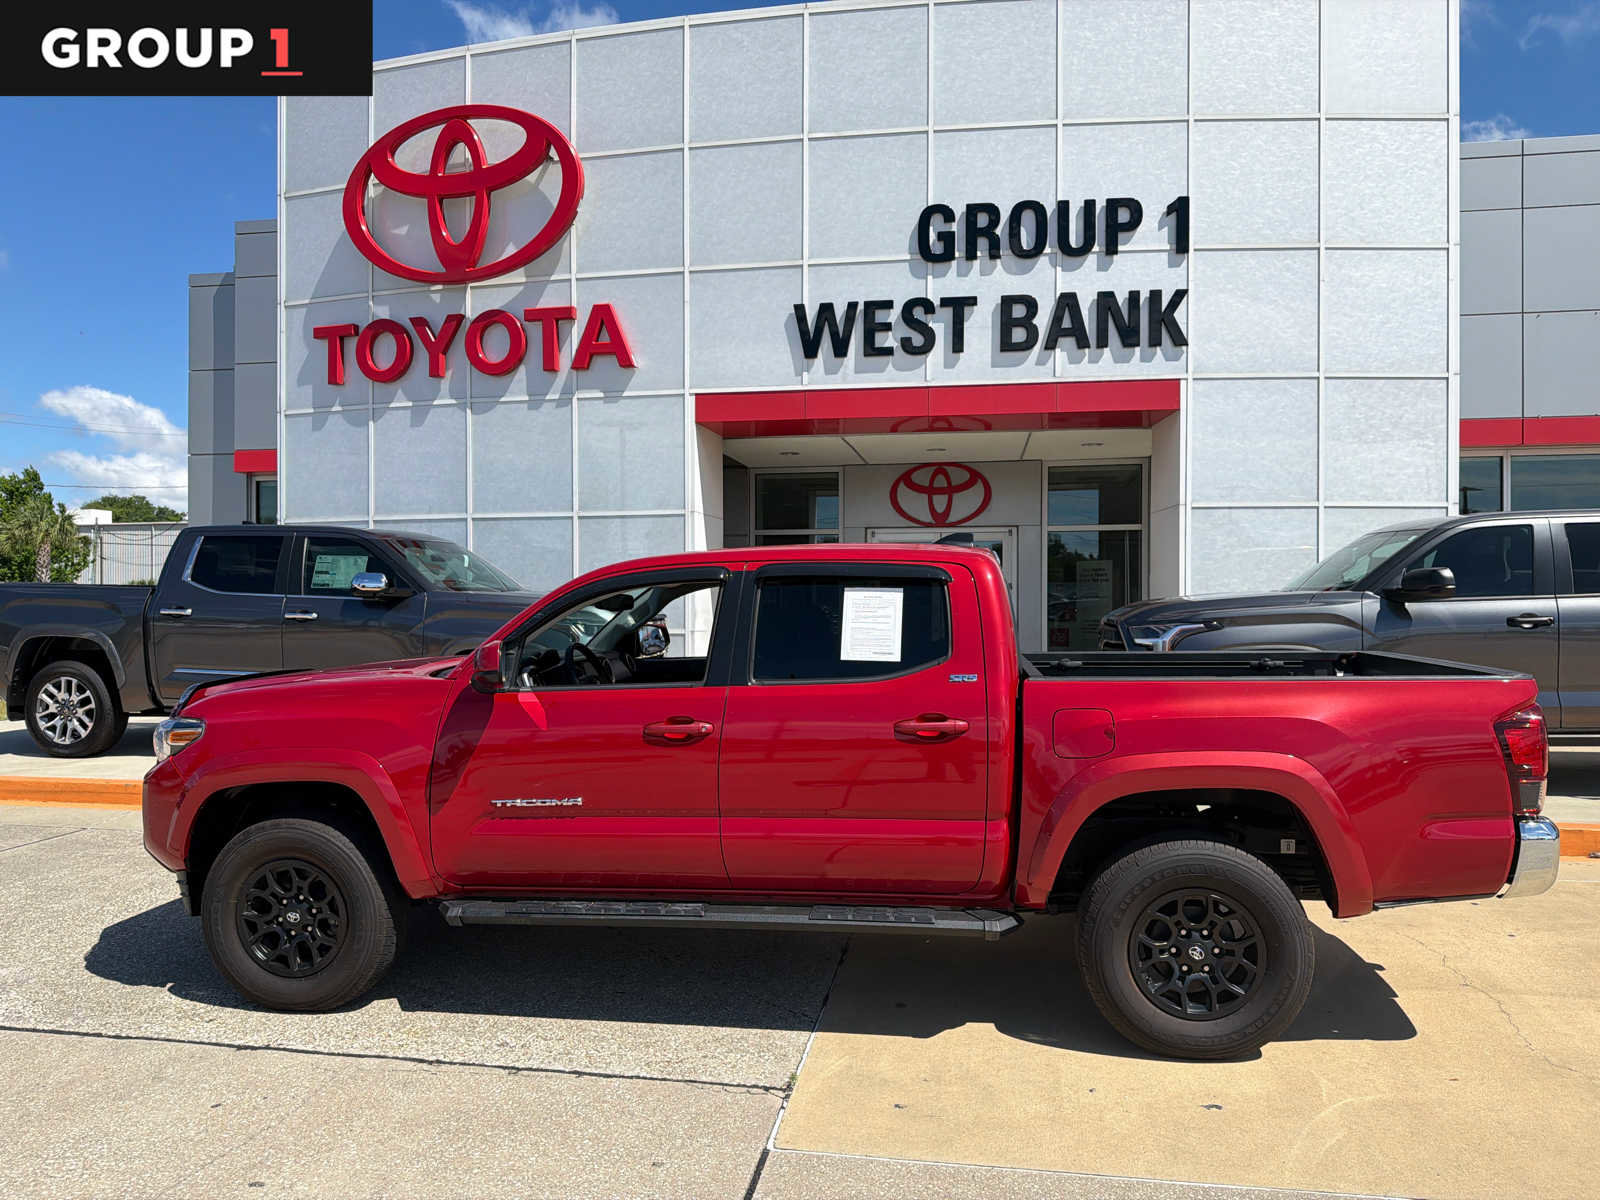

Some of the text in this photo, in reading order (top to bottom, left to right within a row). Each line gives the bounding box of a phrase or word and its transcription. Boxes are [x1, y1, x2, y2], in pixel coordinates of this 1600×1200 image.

[917, 195, 1190, 263] GROUP 1
[313, 303, 637, 385] TOYOTA
[793, 288, 1189, 359] WEST BANK
[491, 797, 583, 807] TACOMA
